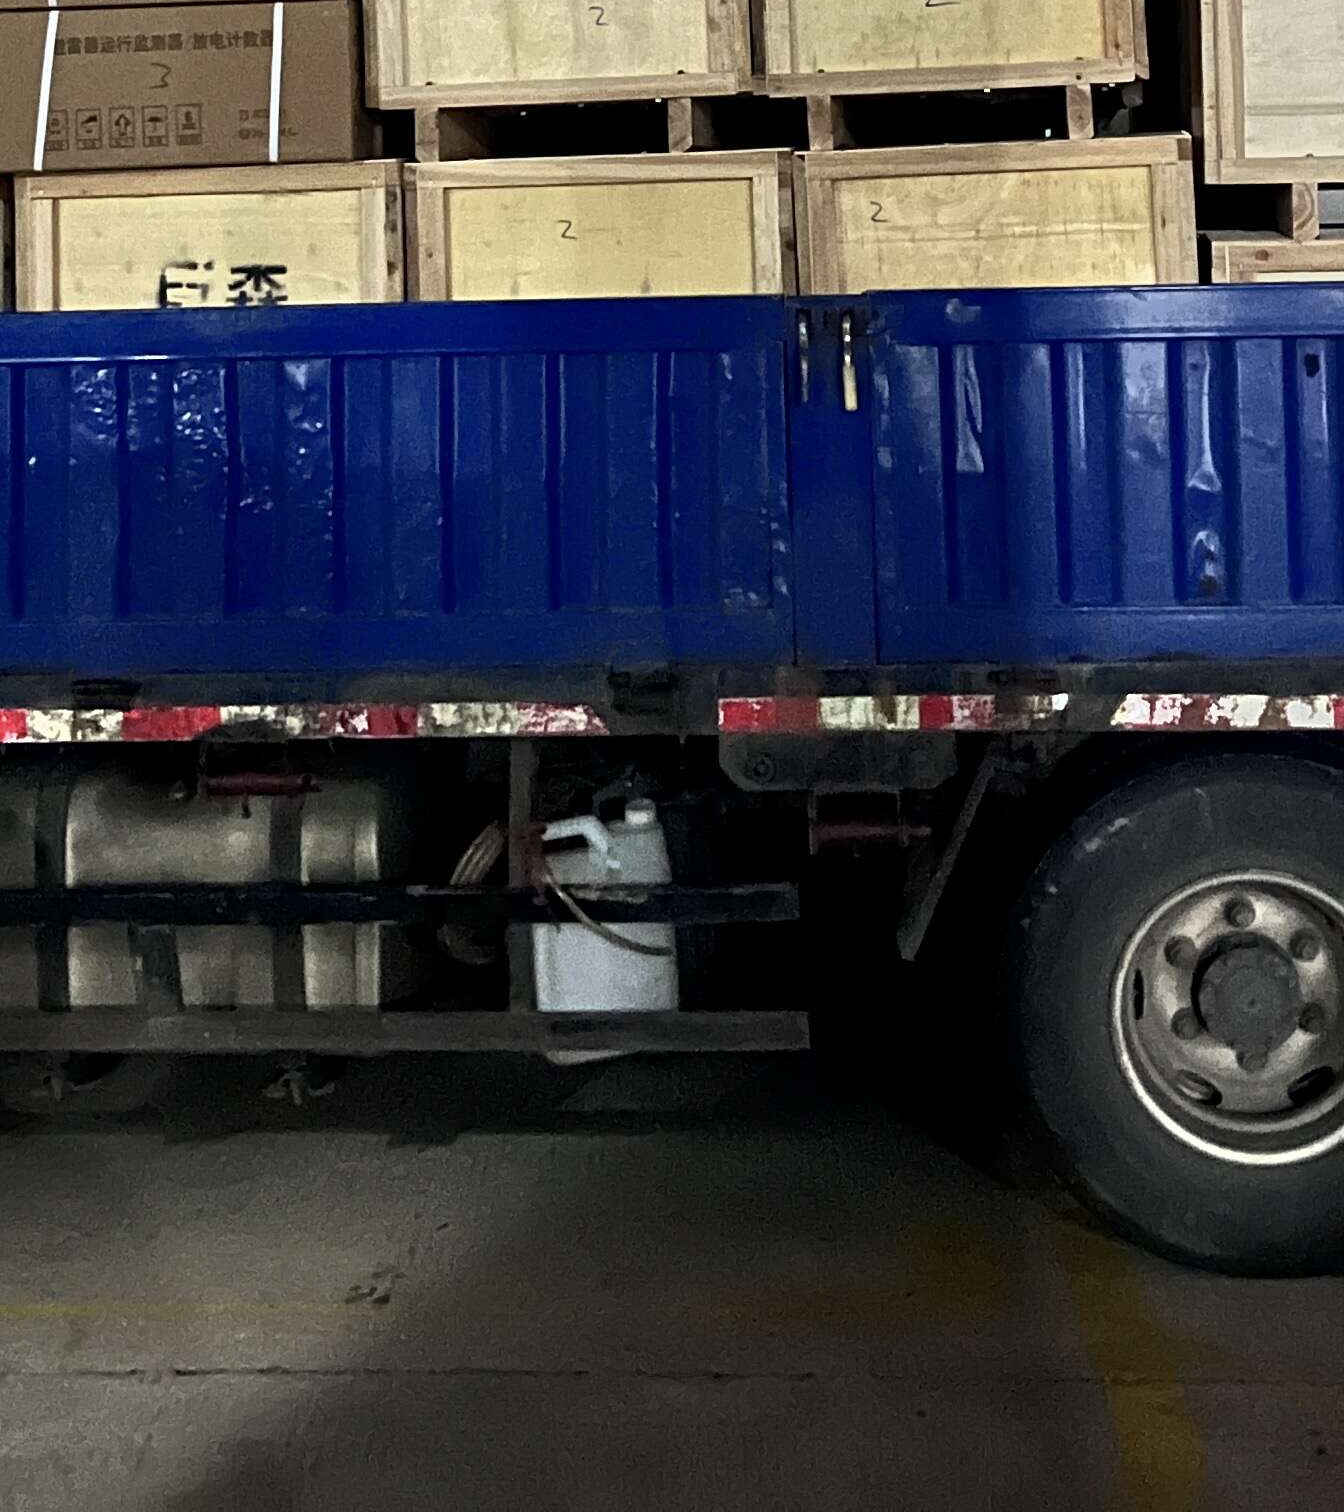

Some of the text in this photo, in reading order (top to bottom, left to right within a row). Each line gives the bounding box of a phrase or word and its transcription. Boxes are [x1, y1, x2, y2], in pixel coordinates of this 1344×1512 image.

[587, 5, 609, 26] 2
[150, 62, 172, 89] 3
[869, 200, 890, 223] 2
[556, 218, 578, 240] 2
